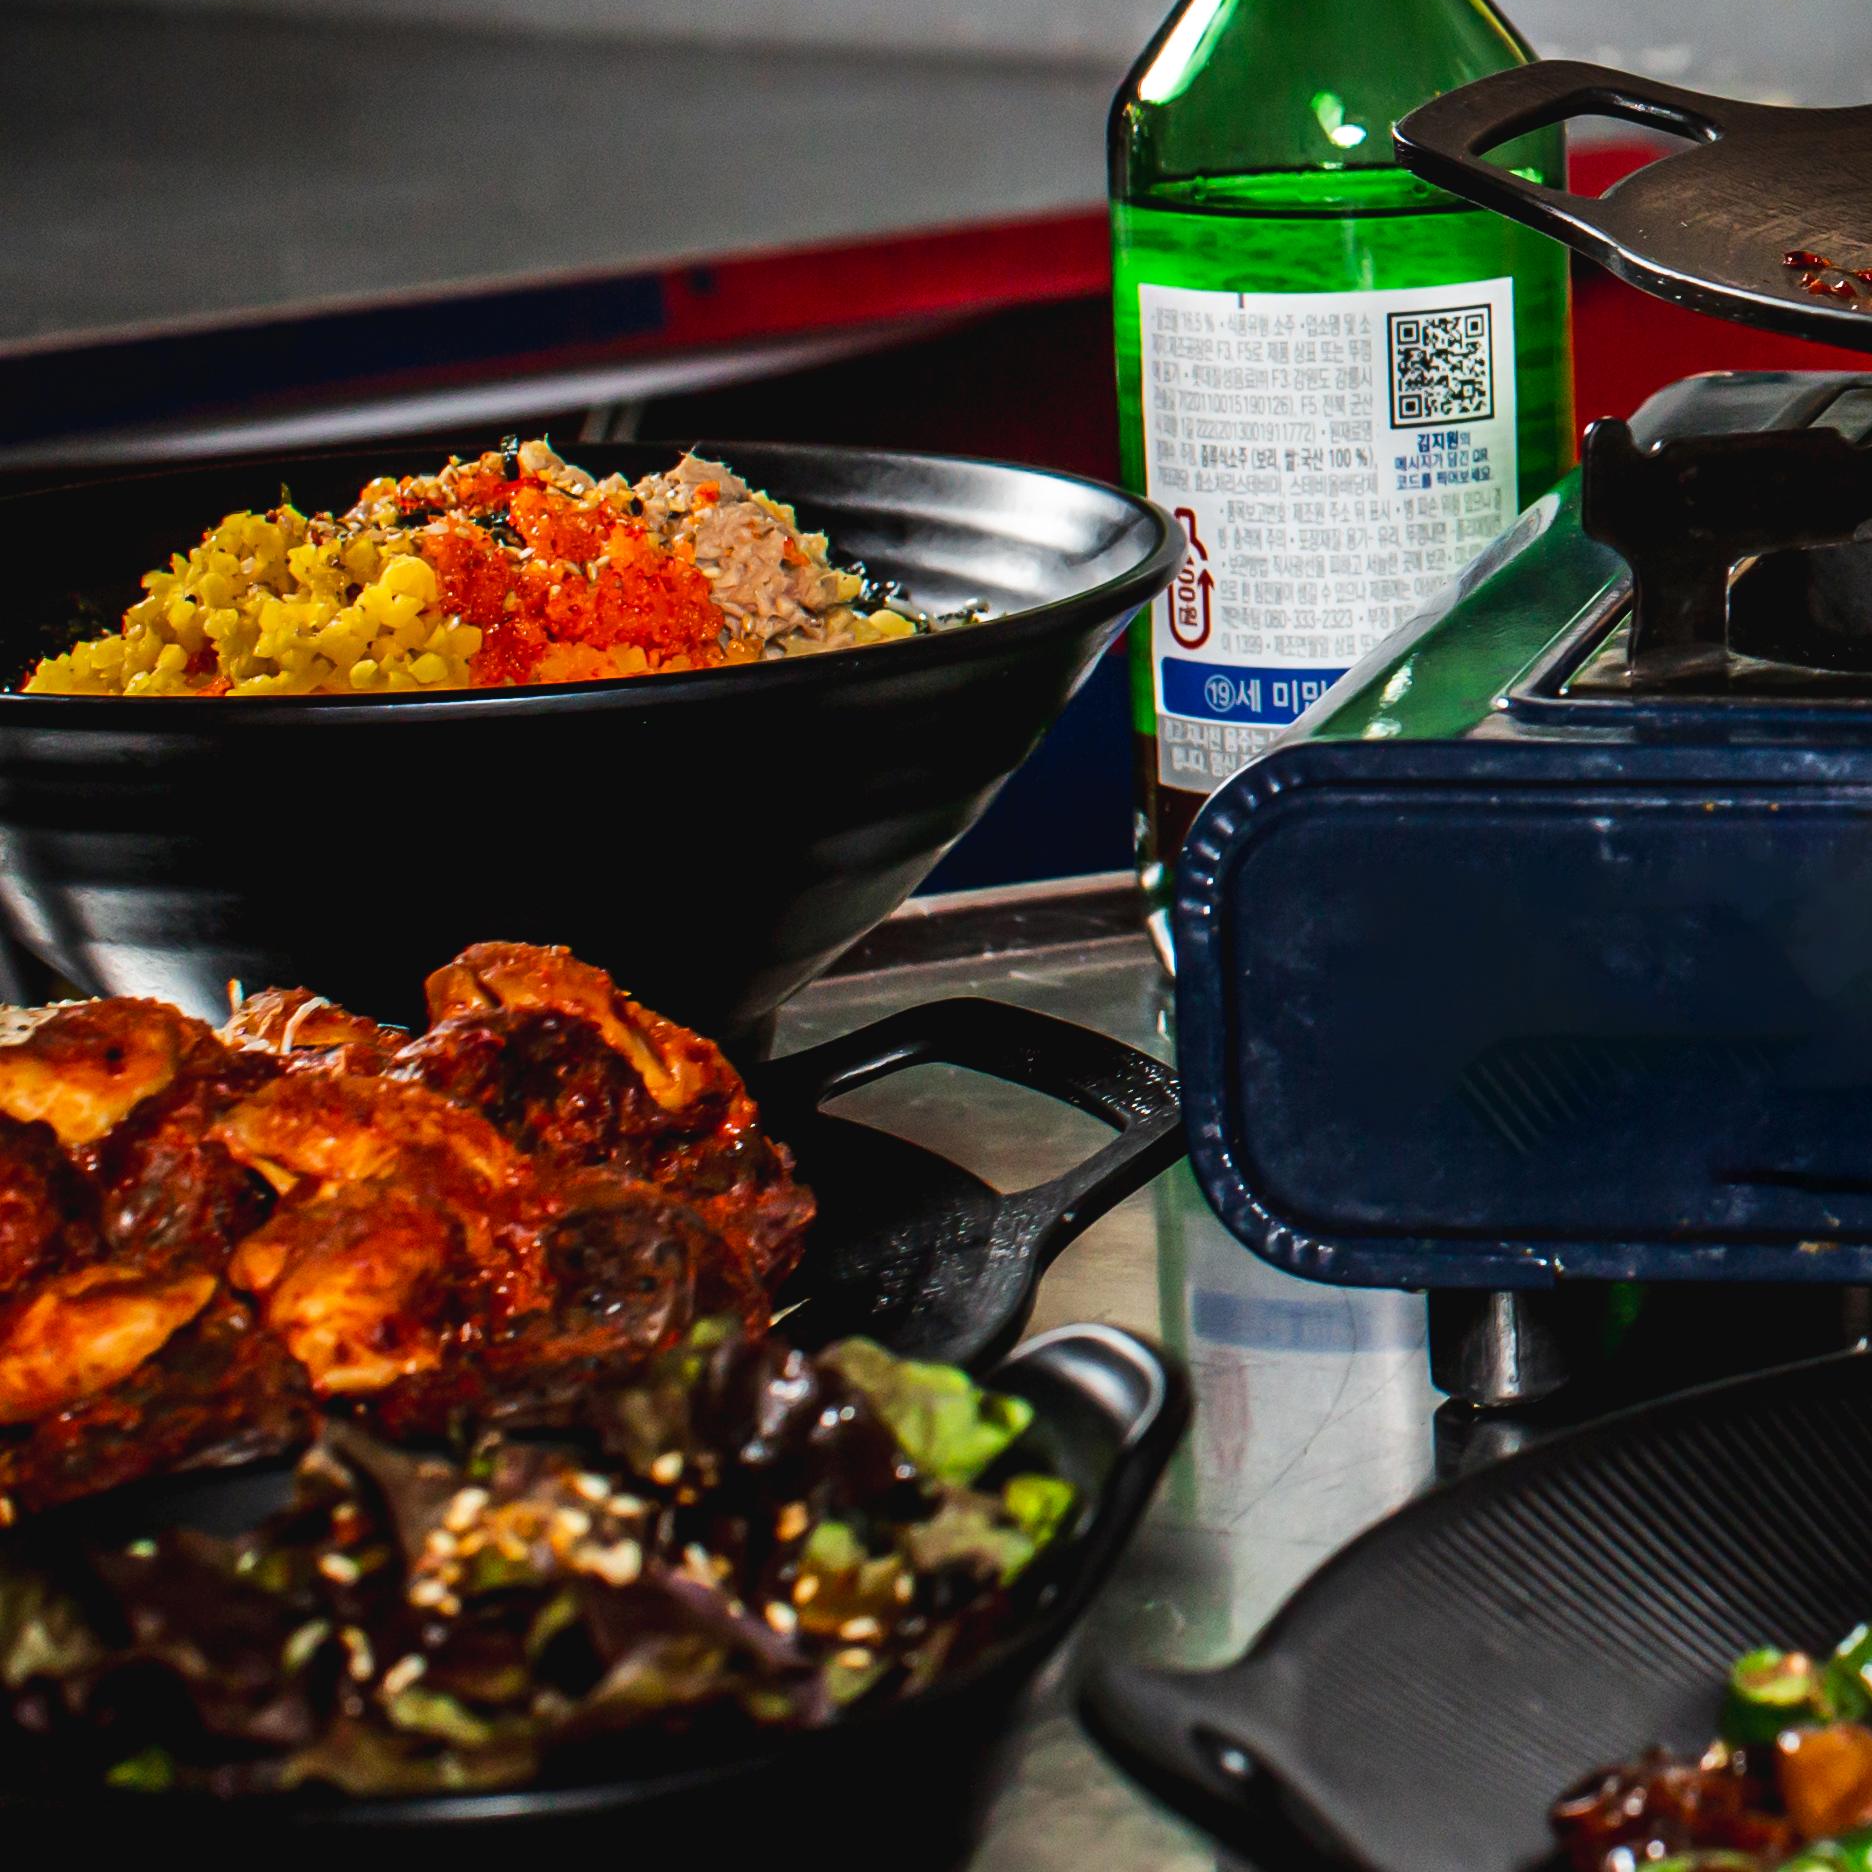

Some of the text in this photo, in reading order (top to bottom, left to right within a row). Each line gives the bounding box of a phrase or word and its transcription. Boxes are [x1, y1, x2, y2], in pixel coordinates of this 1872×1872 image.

[1274, 314, 1295, 336] 소주
[1294, 340, 1317, 364] 상표
[1321, 341, 1345, 364] 또는
[1417, 430, 1470, 453] 김지원의
[1201, 444, 1248, 472] 증류식소주
[1329, 447, 1352, 470] 100
[1394, 453, 1443, 472] 메시지가
[1447, 450, 1469, 468] 담긴
[1329, 501, 1352, 523] 주소
[1369, 499, 1391, 522] 표시
